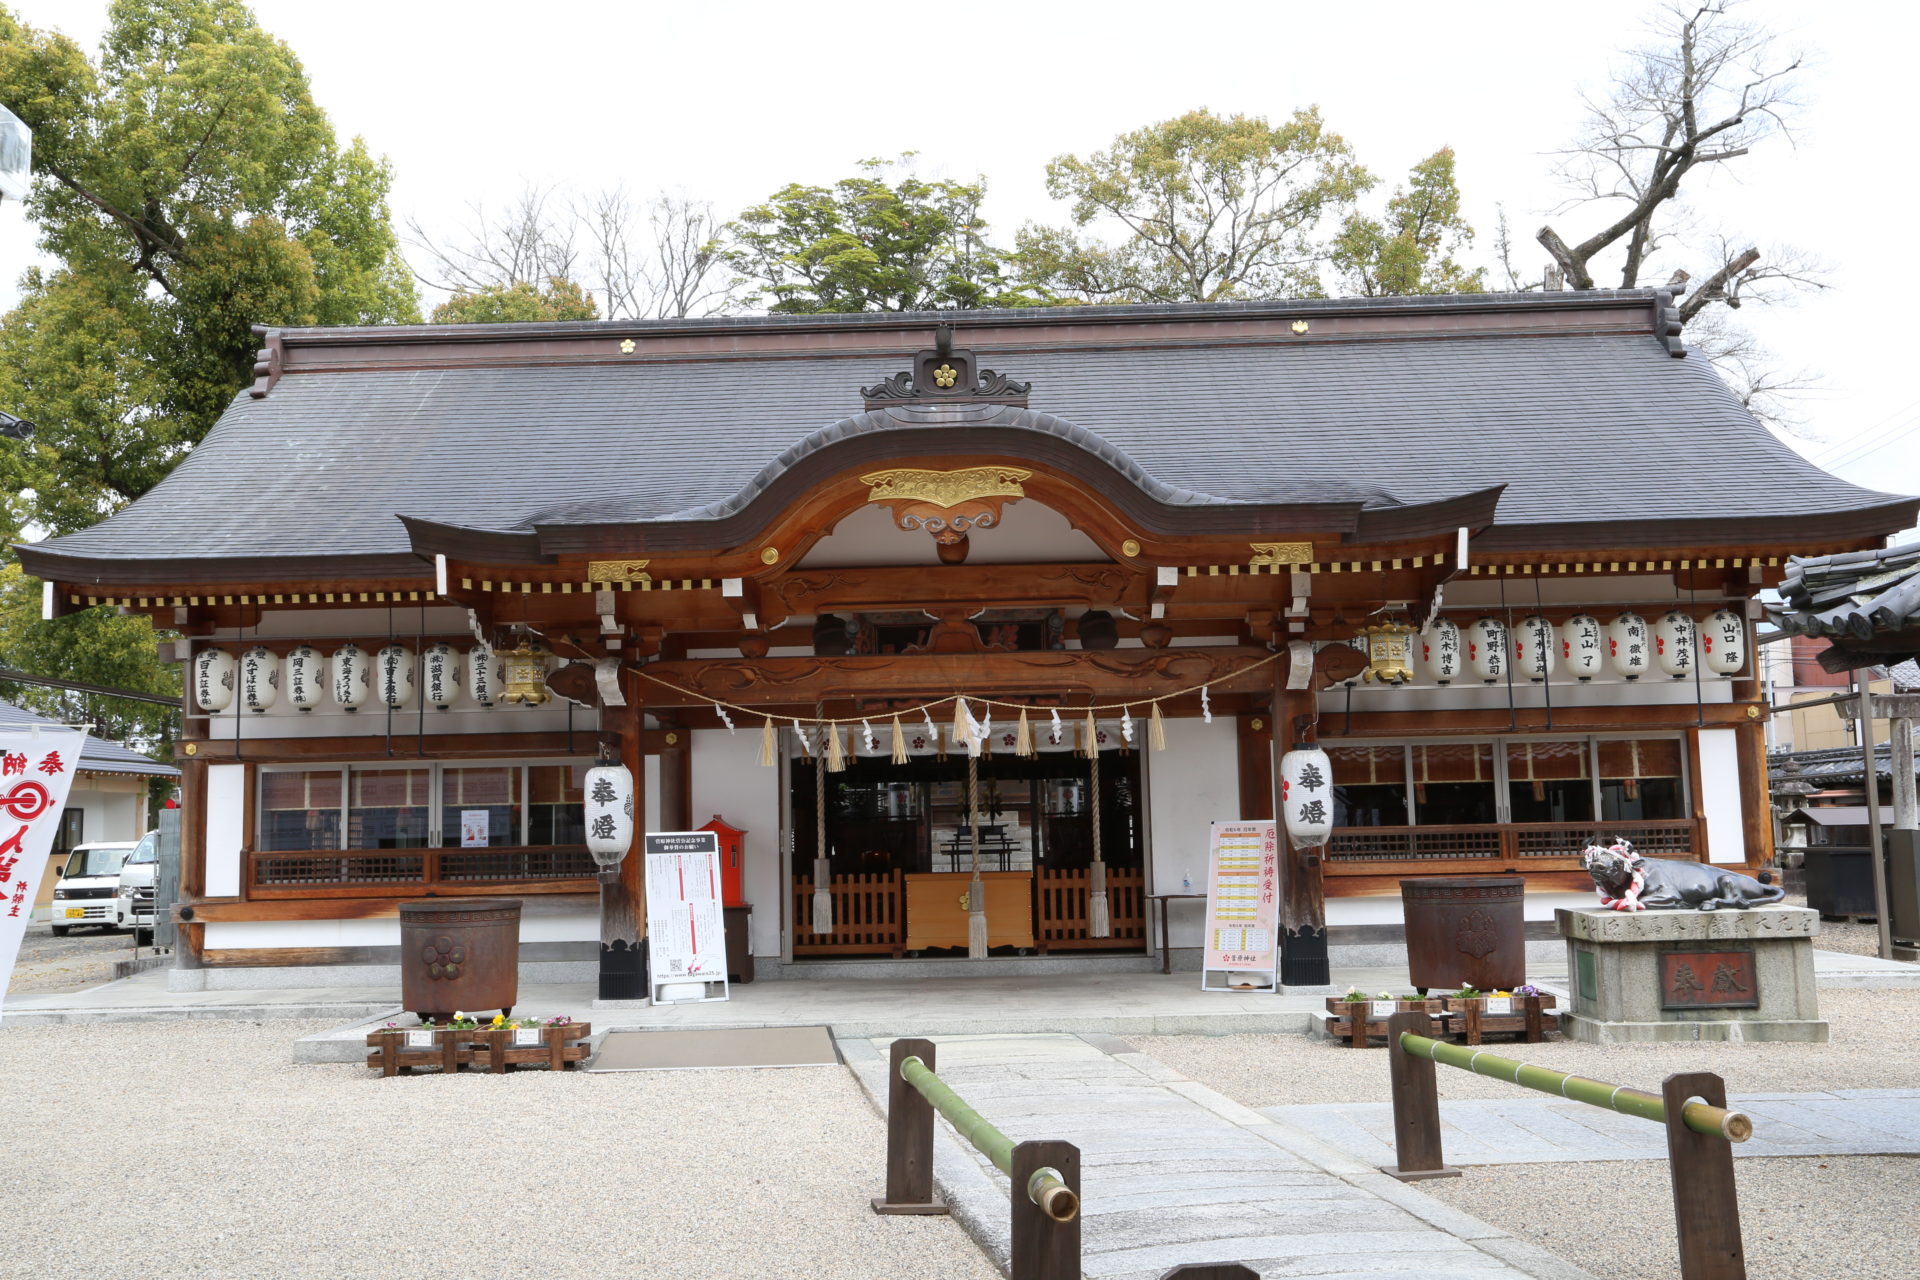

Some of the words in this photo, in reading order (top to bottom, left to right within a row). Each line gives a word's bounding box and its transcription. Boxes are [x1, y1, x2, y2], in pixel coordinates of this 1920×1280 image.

[1440, 630, 1453, 675] 荒木博吉
[1581, 628, 1593, 667] 上山了
[1675, 625, 1689, 668] 中井茂平
[1723, 624, 1738, 663] 山口隆
[341, 657, 353, 704] 東海ろうきん
[591, 778, 618, 840] 奉燈
[1297, 763, 1326, 824] 奉燈
